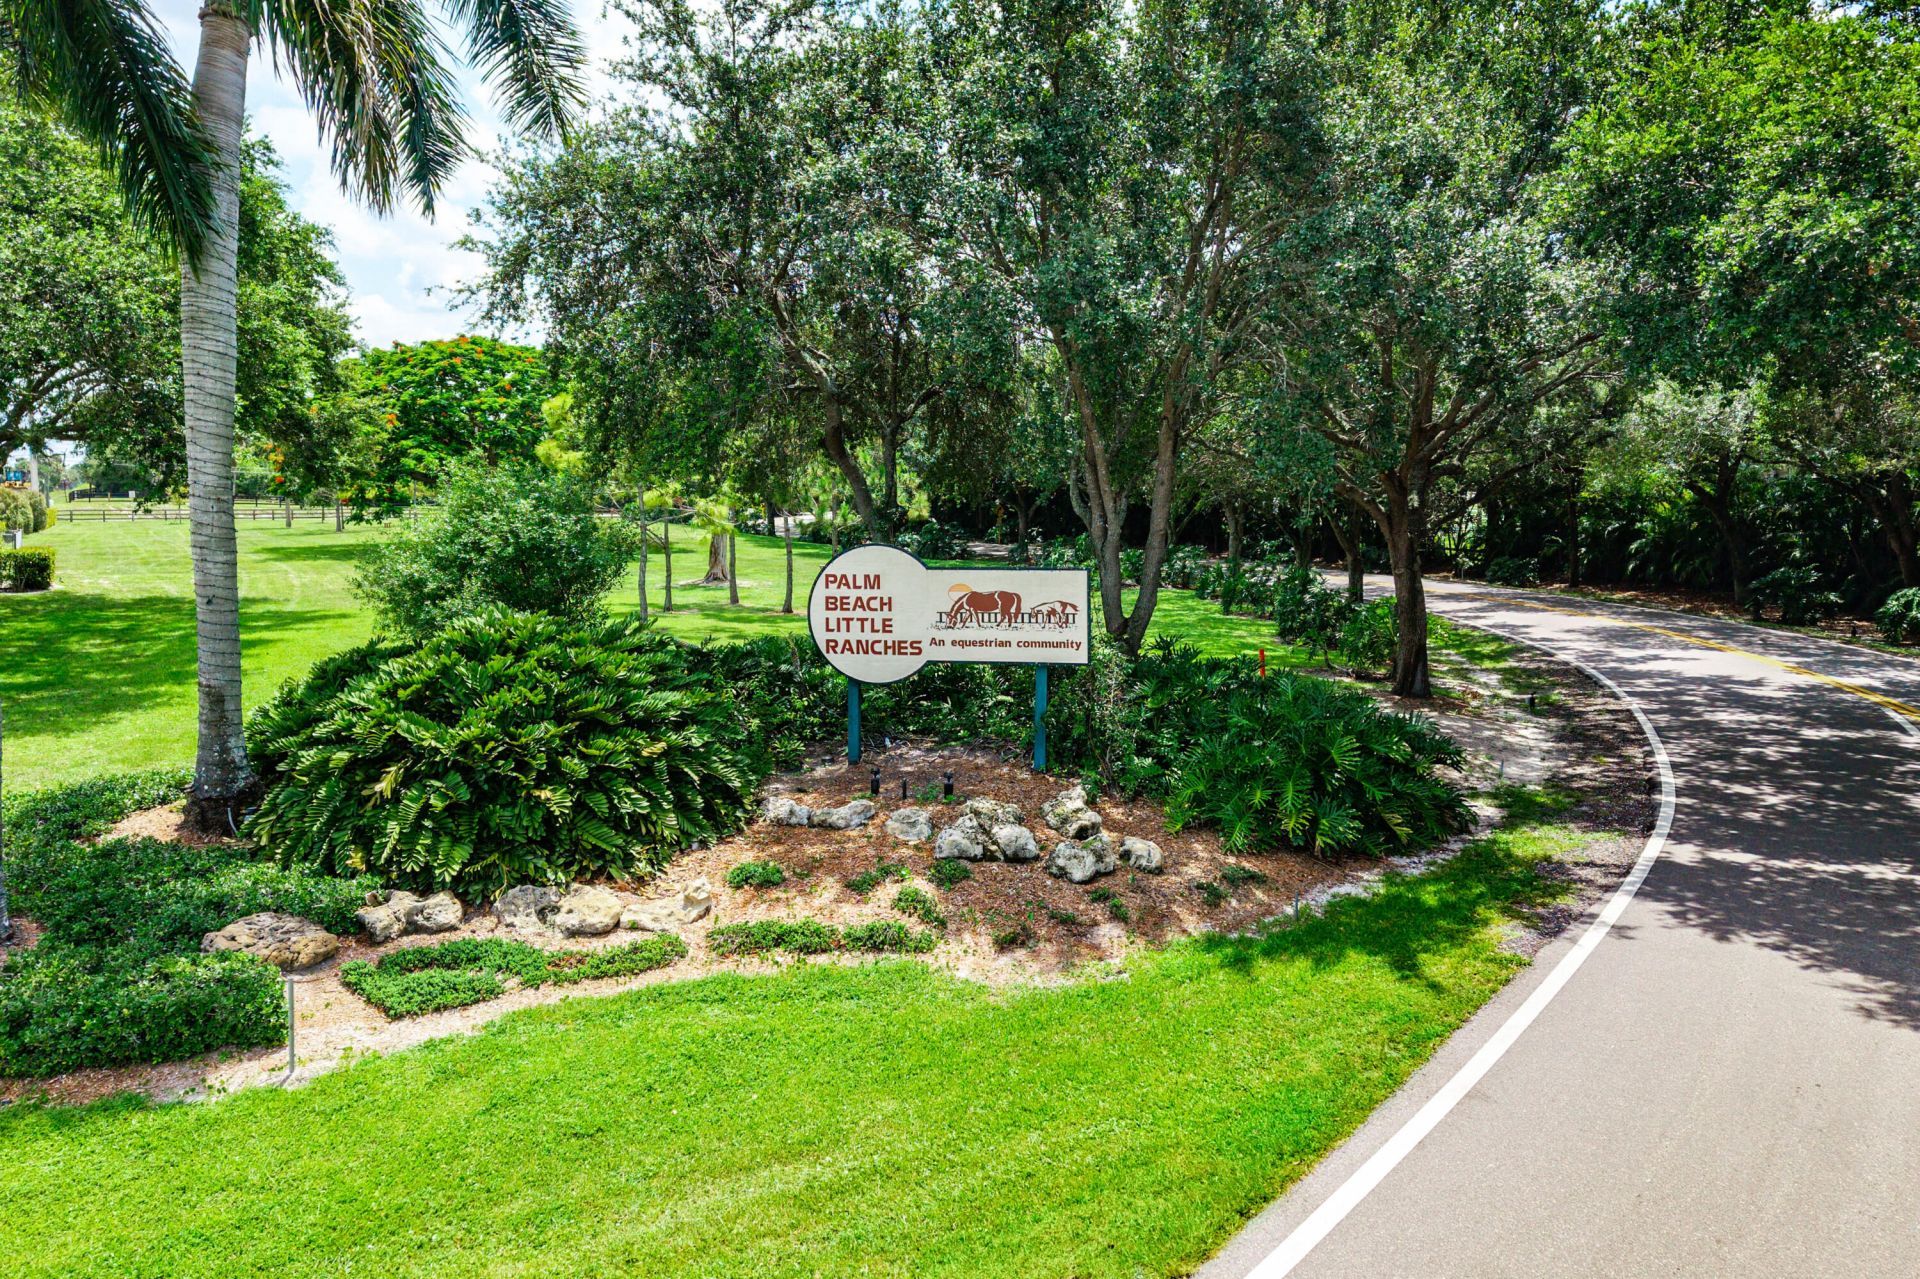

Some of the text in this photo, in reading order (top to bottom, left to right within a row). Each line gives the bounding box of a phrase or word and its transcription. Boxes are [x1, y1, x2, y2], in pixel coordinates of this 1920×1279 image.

[825, 574, 881, 590] PALM
[825, 596, 893, 612] BEACH
[825, 617, 894, 634] LITTLE
[825, 639, 923, 656] RANCHES
[929, 637, 1082, 651] An equestrian community
